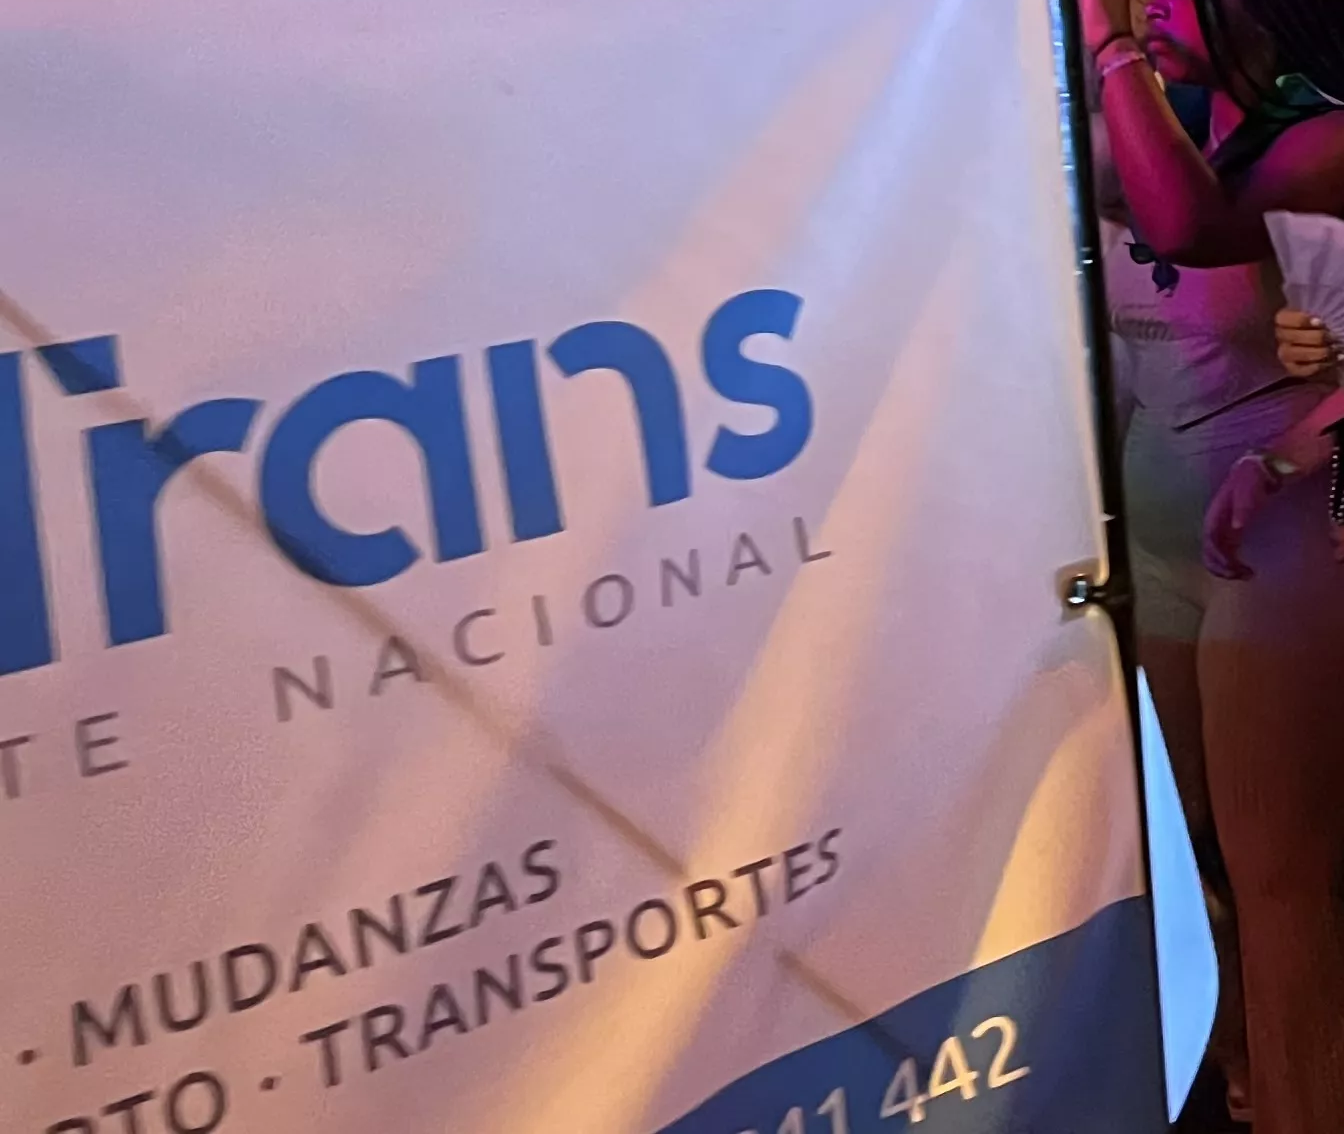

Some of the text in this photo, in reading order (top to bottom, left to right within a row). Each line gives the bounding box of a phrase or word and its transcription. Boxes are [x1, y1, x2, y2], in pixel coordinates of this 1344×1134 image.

[270, 516, 833, 723] NACIONAL
[45, 827, 844, 1134] TO TRANSPORTES
[71, 838, 561, 1067] MUDANZAS
[880, 1015, 1031, 1124] 442
